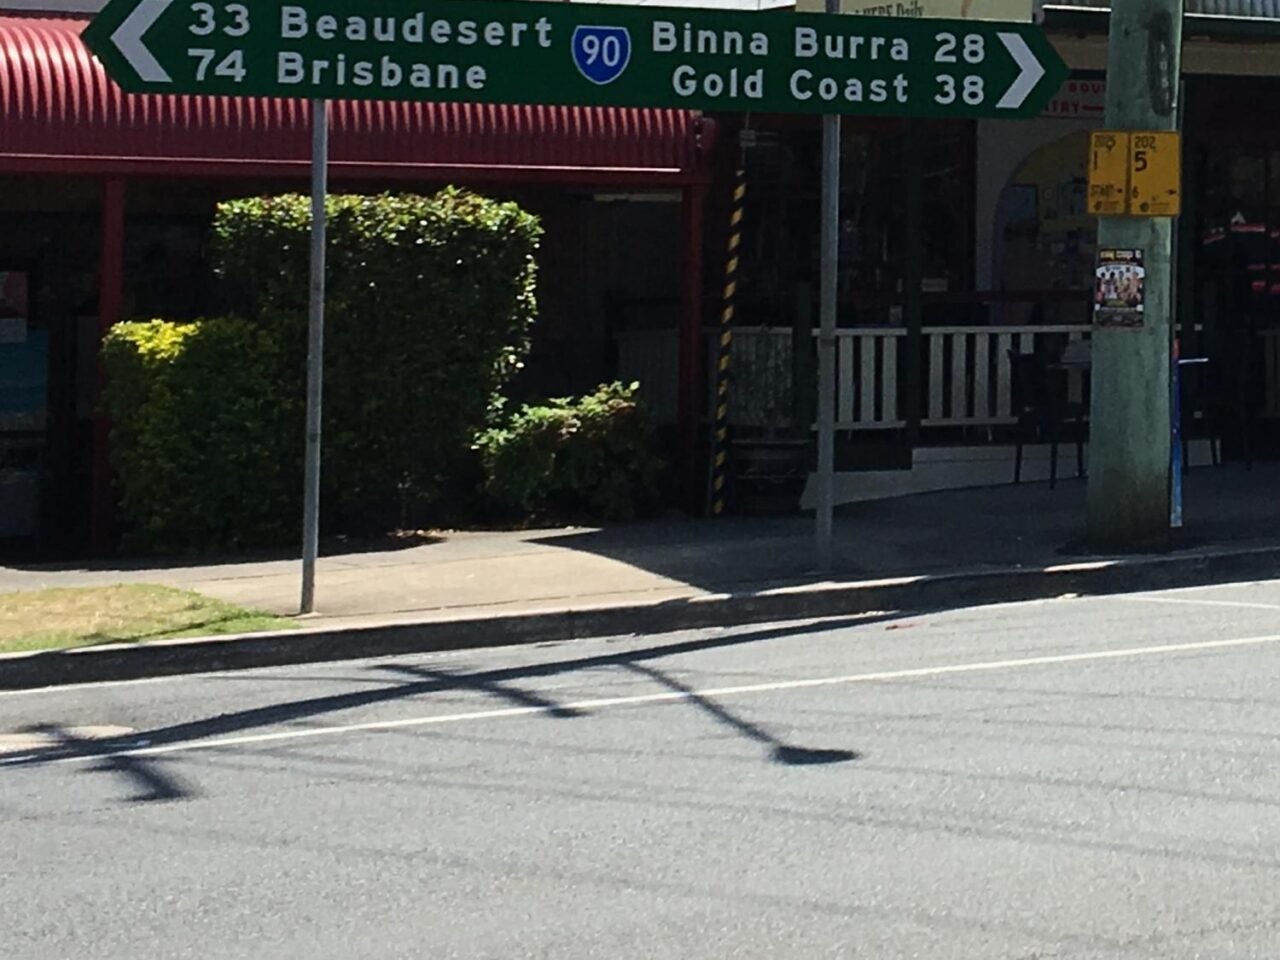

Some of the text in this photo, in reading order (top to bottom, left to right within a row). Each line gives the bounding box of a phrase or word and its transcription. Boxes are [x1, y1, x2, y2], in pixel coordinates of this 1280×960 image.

[188, 3, 552, 47] 33 Beaudesert
[653, 21, 985, 64] Binna Burra 28
[188, 49, 487, 90] 74 Brisbane
[582, 35, 620, 67] 90
[672, 65, 984, 105] Gold Coast 38
[1134, 135, 1157, 151] 202
[1134, 151, 1148, 172] 5
